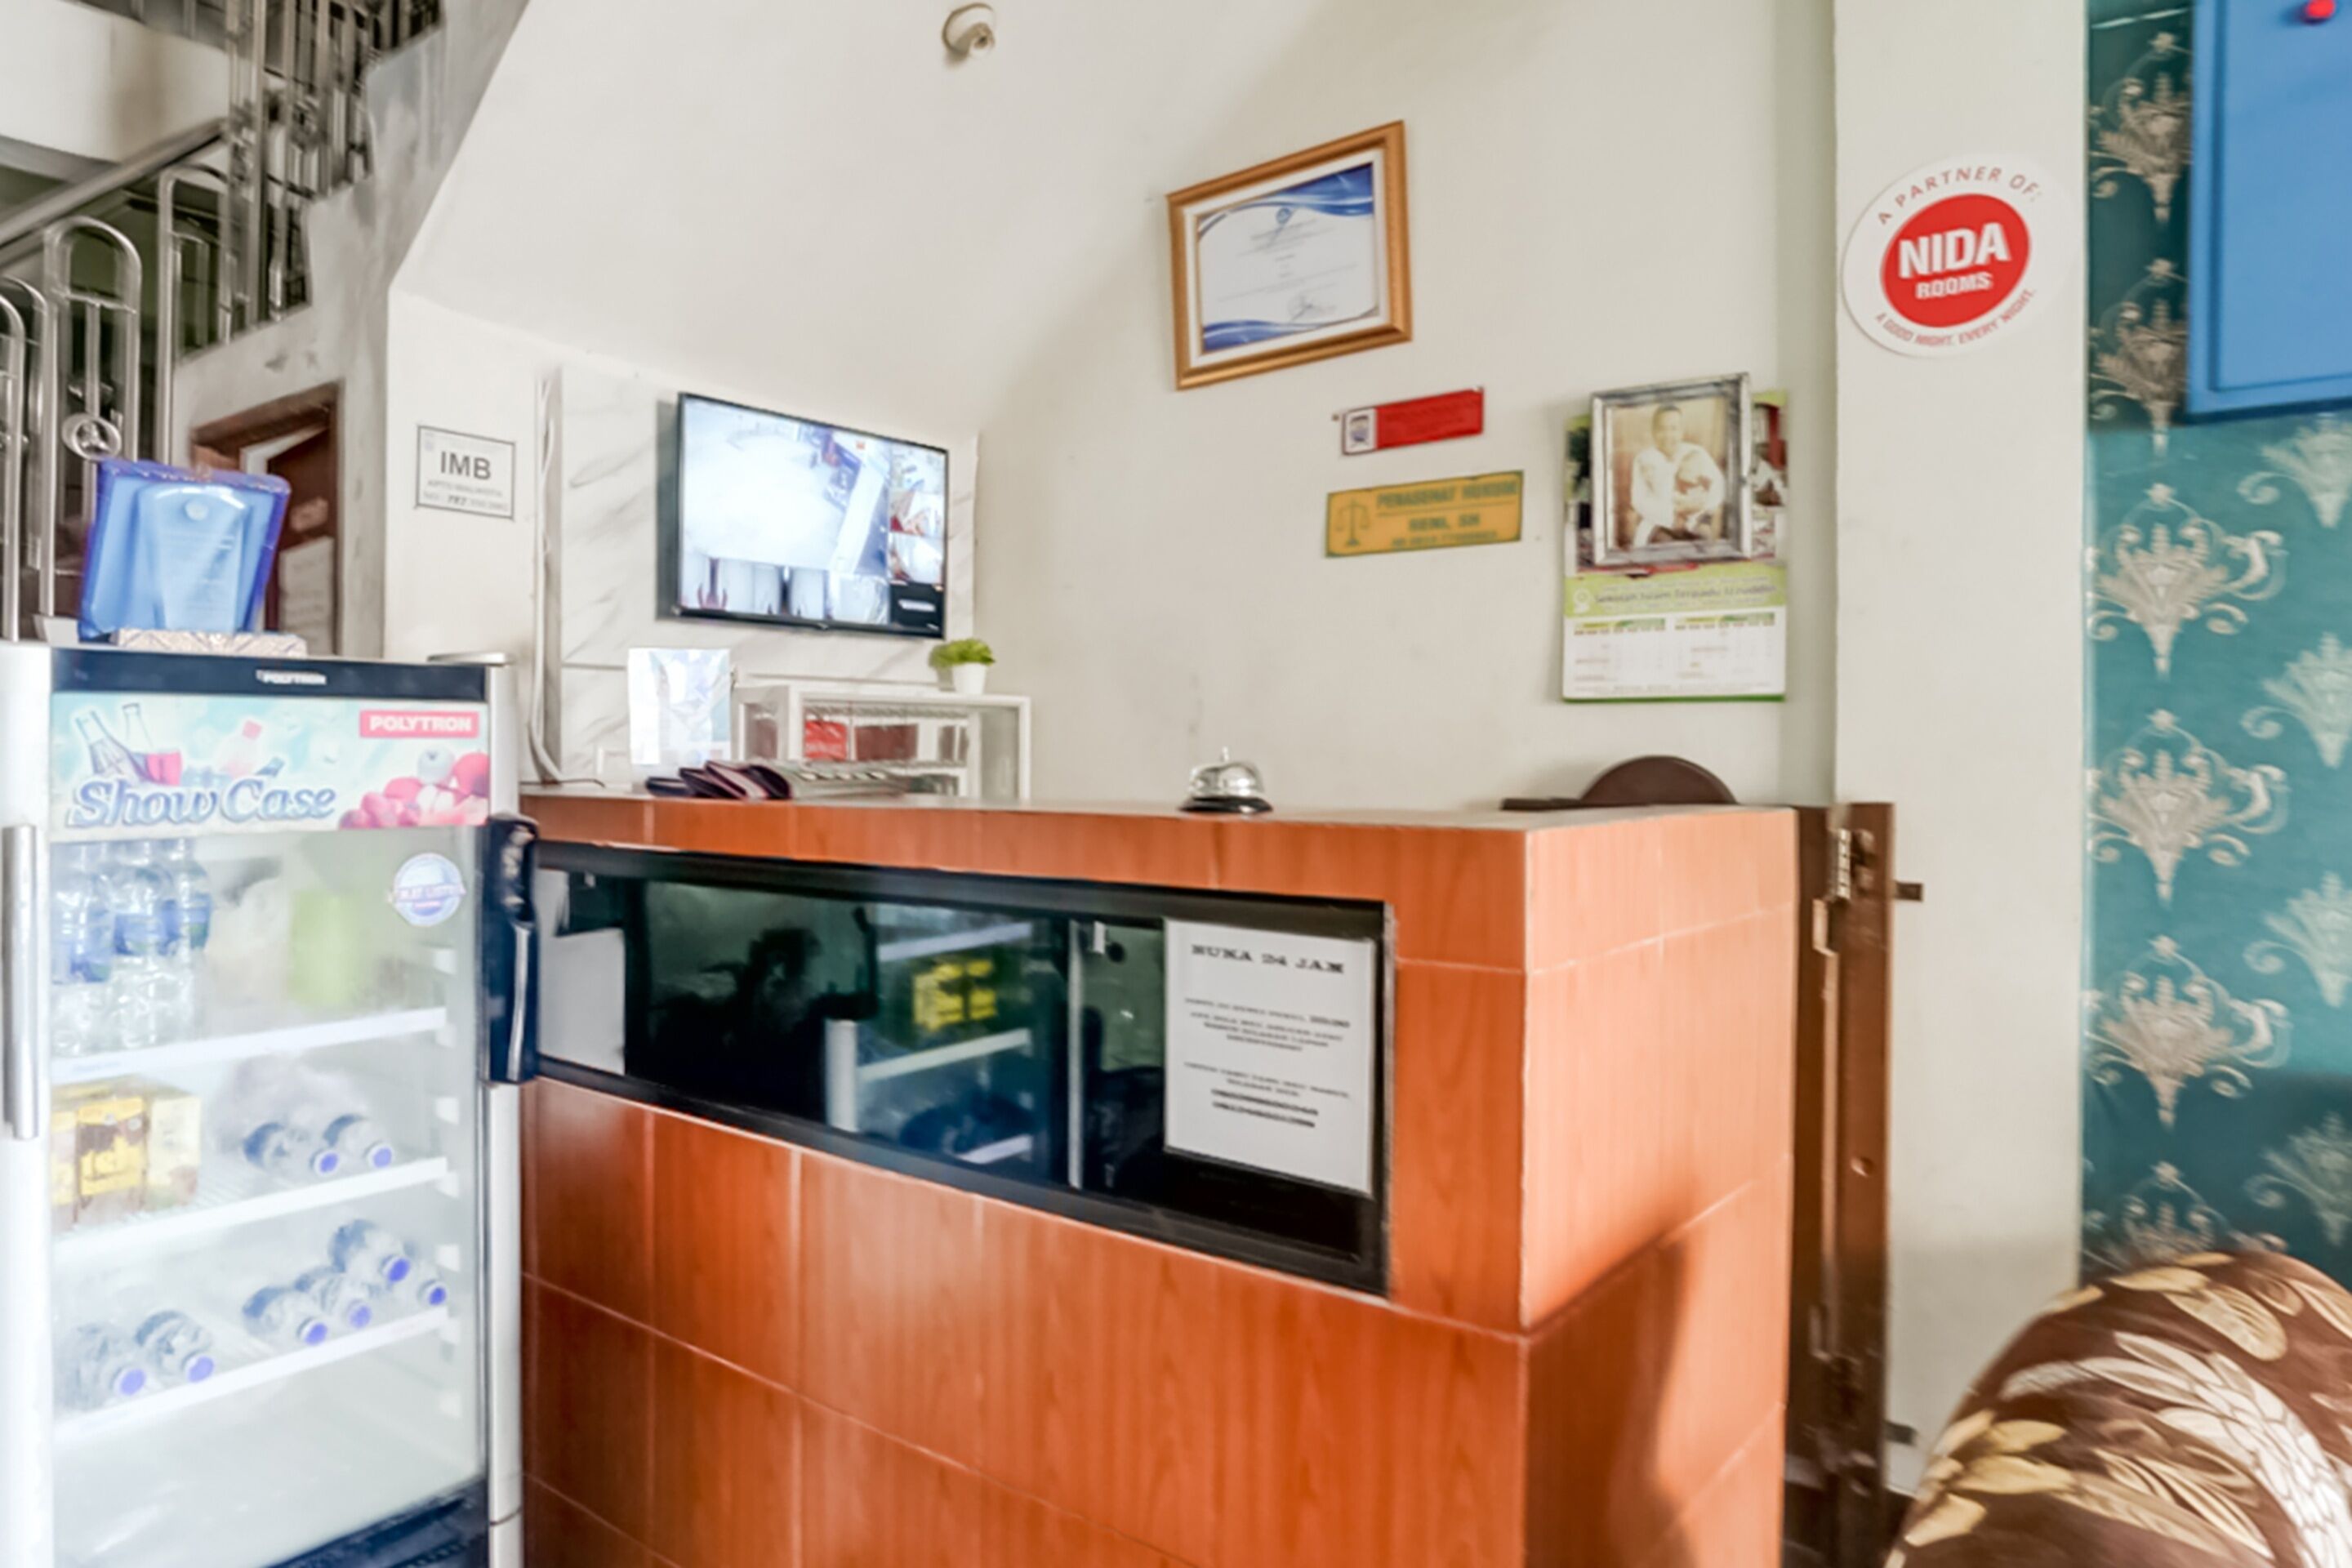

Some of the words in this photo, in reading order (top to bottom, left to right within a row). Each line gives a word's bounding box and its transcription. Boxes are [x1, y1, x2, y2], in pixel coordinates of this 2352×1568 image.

[1878, 212, 1892, 225] A
[1895, 166, 2002, 207] PARTNER
[1899, 221, 2011, 279] NIDA
[1915, 271, 1993, 300] ROOMS
[1883, 318, 1914, 341] GOOD
[1958, 321, 1999, 344] EVERY
[441, 451, 492, 480] IMB
[369, 714, 472, 733] POLYTRON
[71, 775, 219, 827] Show
[220, 773, 336, 822] Case
[1261, 952, 1288, 966] 24
[1295, 957, 1345, 974] JAM
